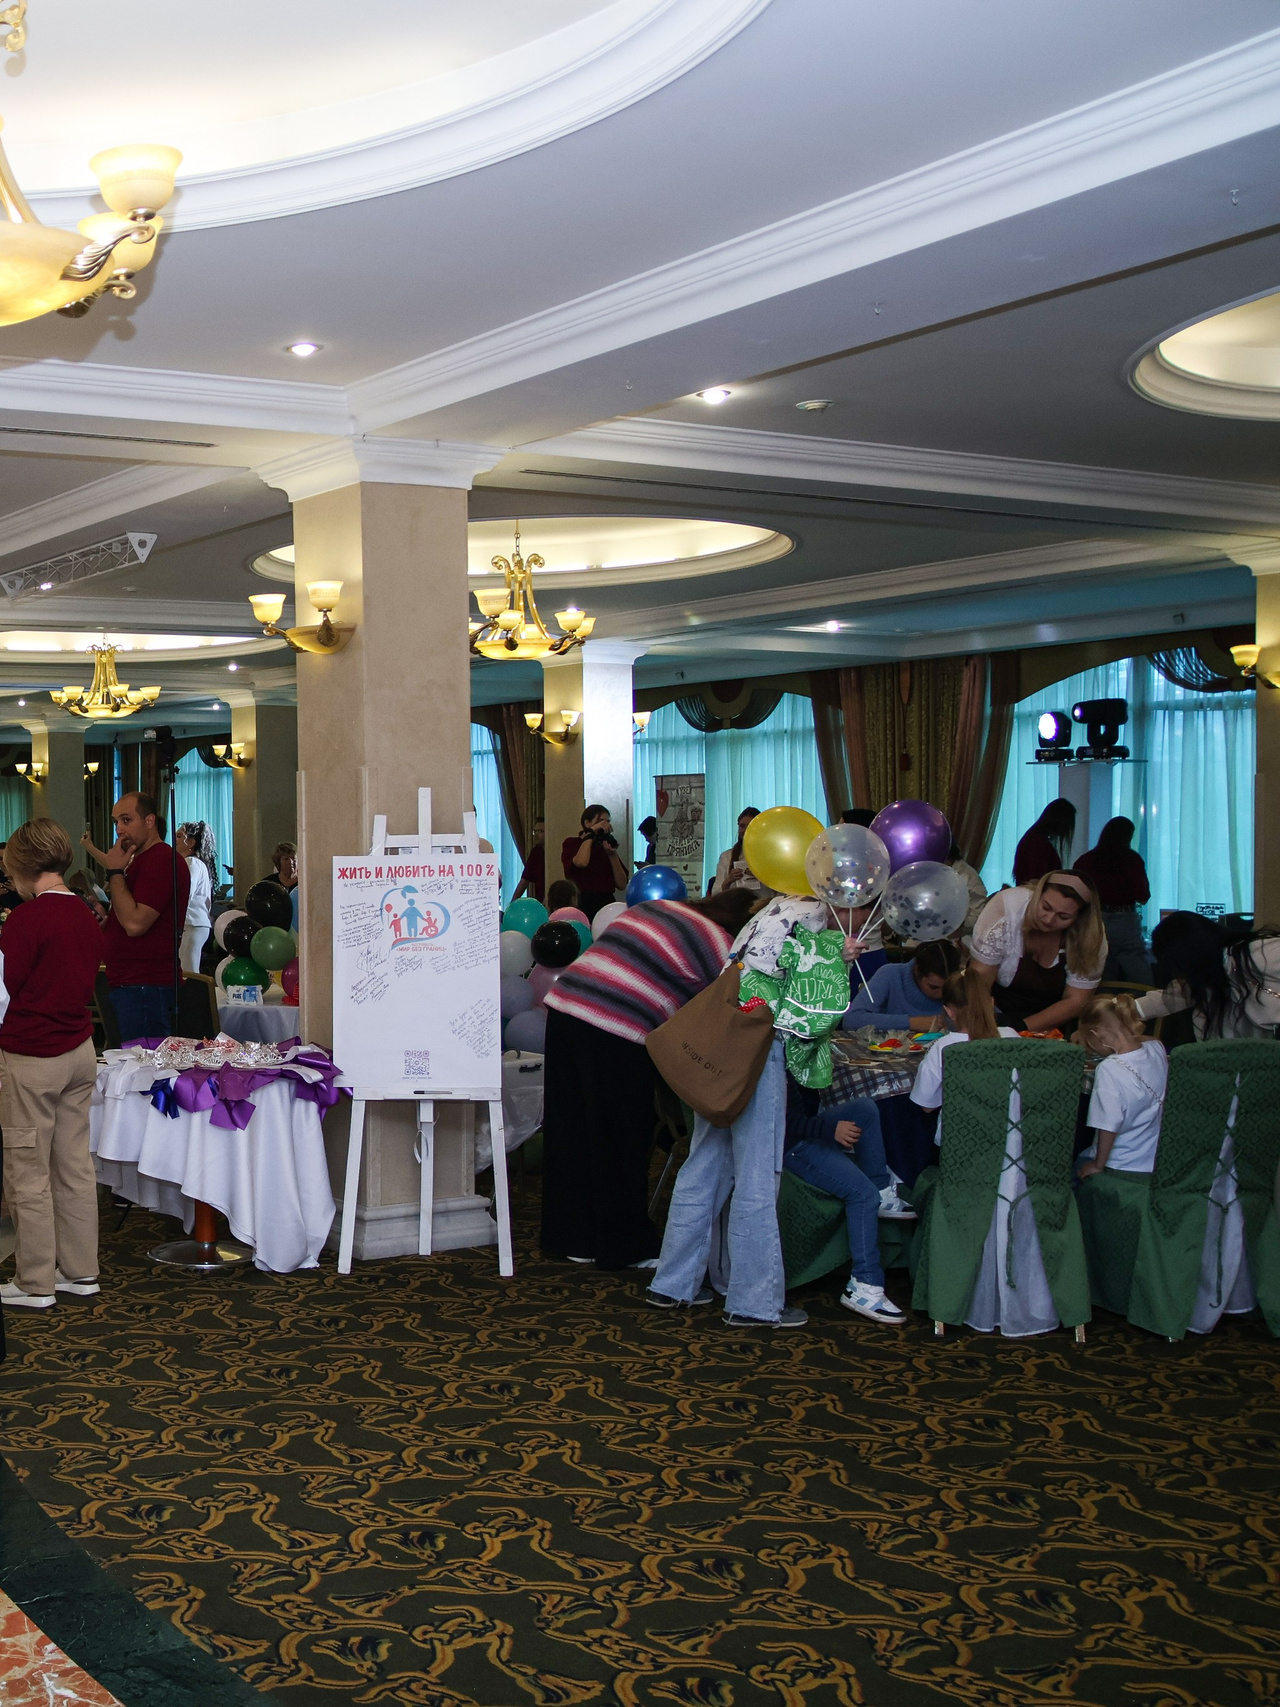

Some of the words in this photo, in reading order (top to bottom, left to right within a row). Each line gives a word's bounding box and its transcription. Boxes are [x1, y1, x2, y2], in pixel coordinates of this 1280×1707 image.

[337, 866, 372, 880] ЖИТЬ
[374, 866, 383, 879] И
[386, 865, 435, 879] ЛЮБИТЬ
[438, 864, 455, 878] НА
[459, 863, 483, 877] 100
[704, 1062, 723, 1076] OUT
